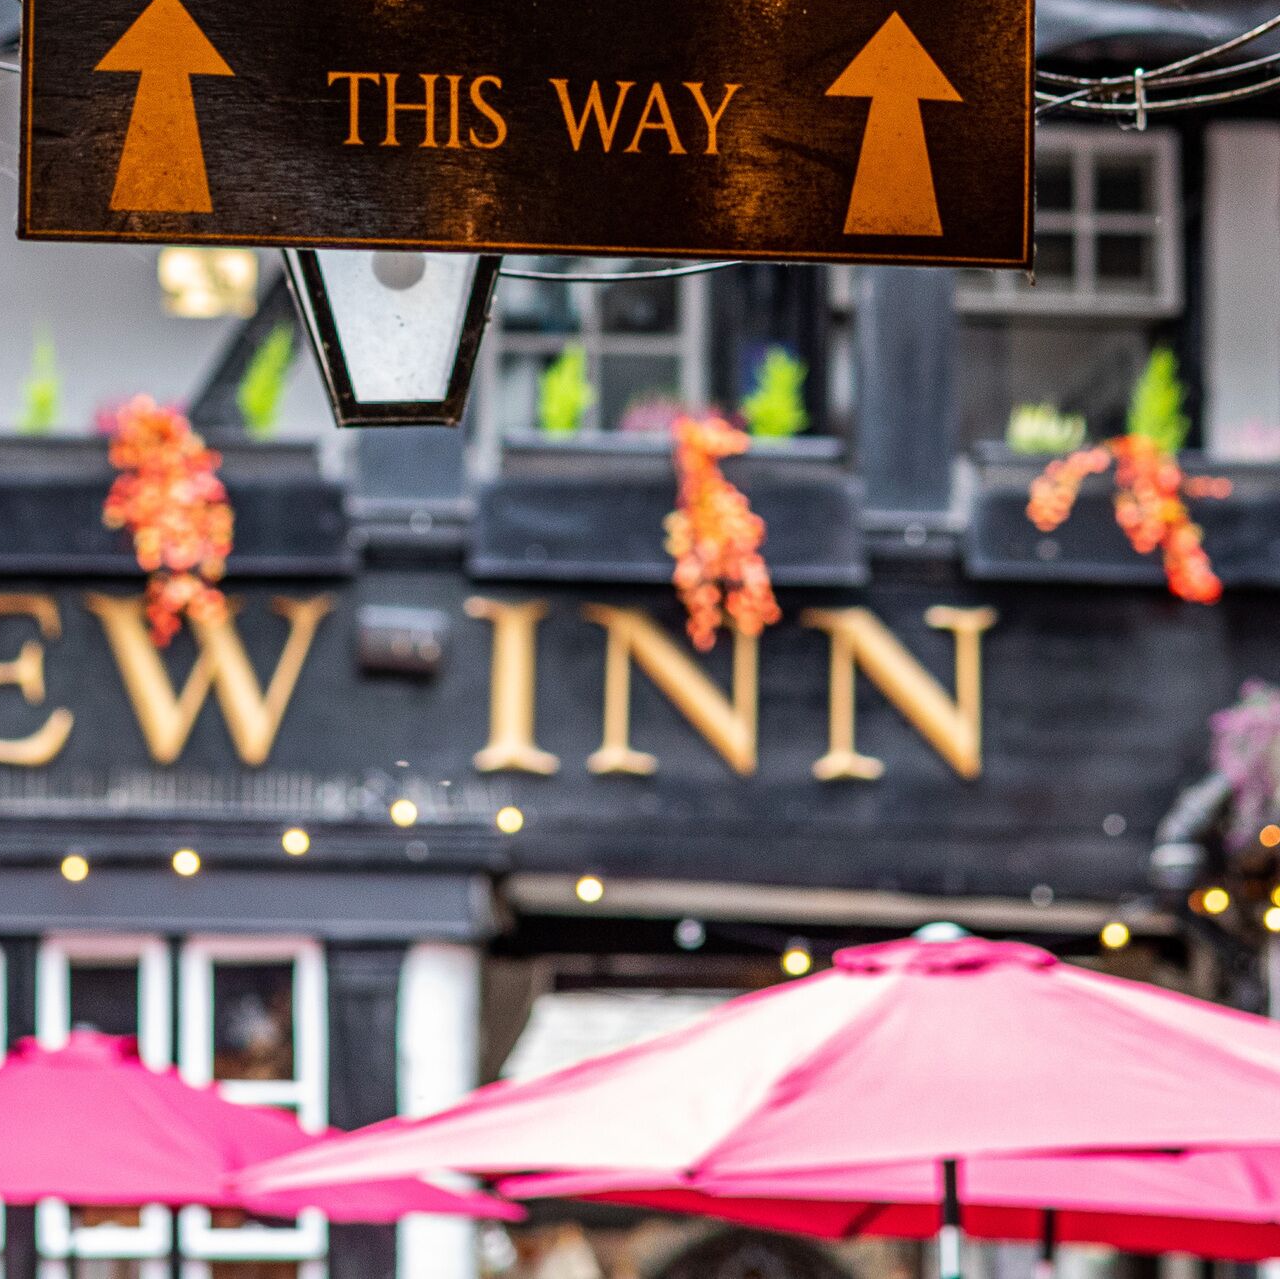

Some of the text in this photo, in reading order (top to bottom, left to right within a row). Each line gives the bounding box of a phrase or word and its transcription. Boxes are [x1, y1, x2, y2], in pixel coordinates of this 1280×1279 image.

[327, 70, 743, 156] THIS WAY
[464, 595, 997, 782] INN
